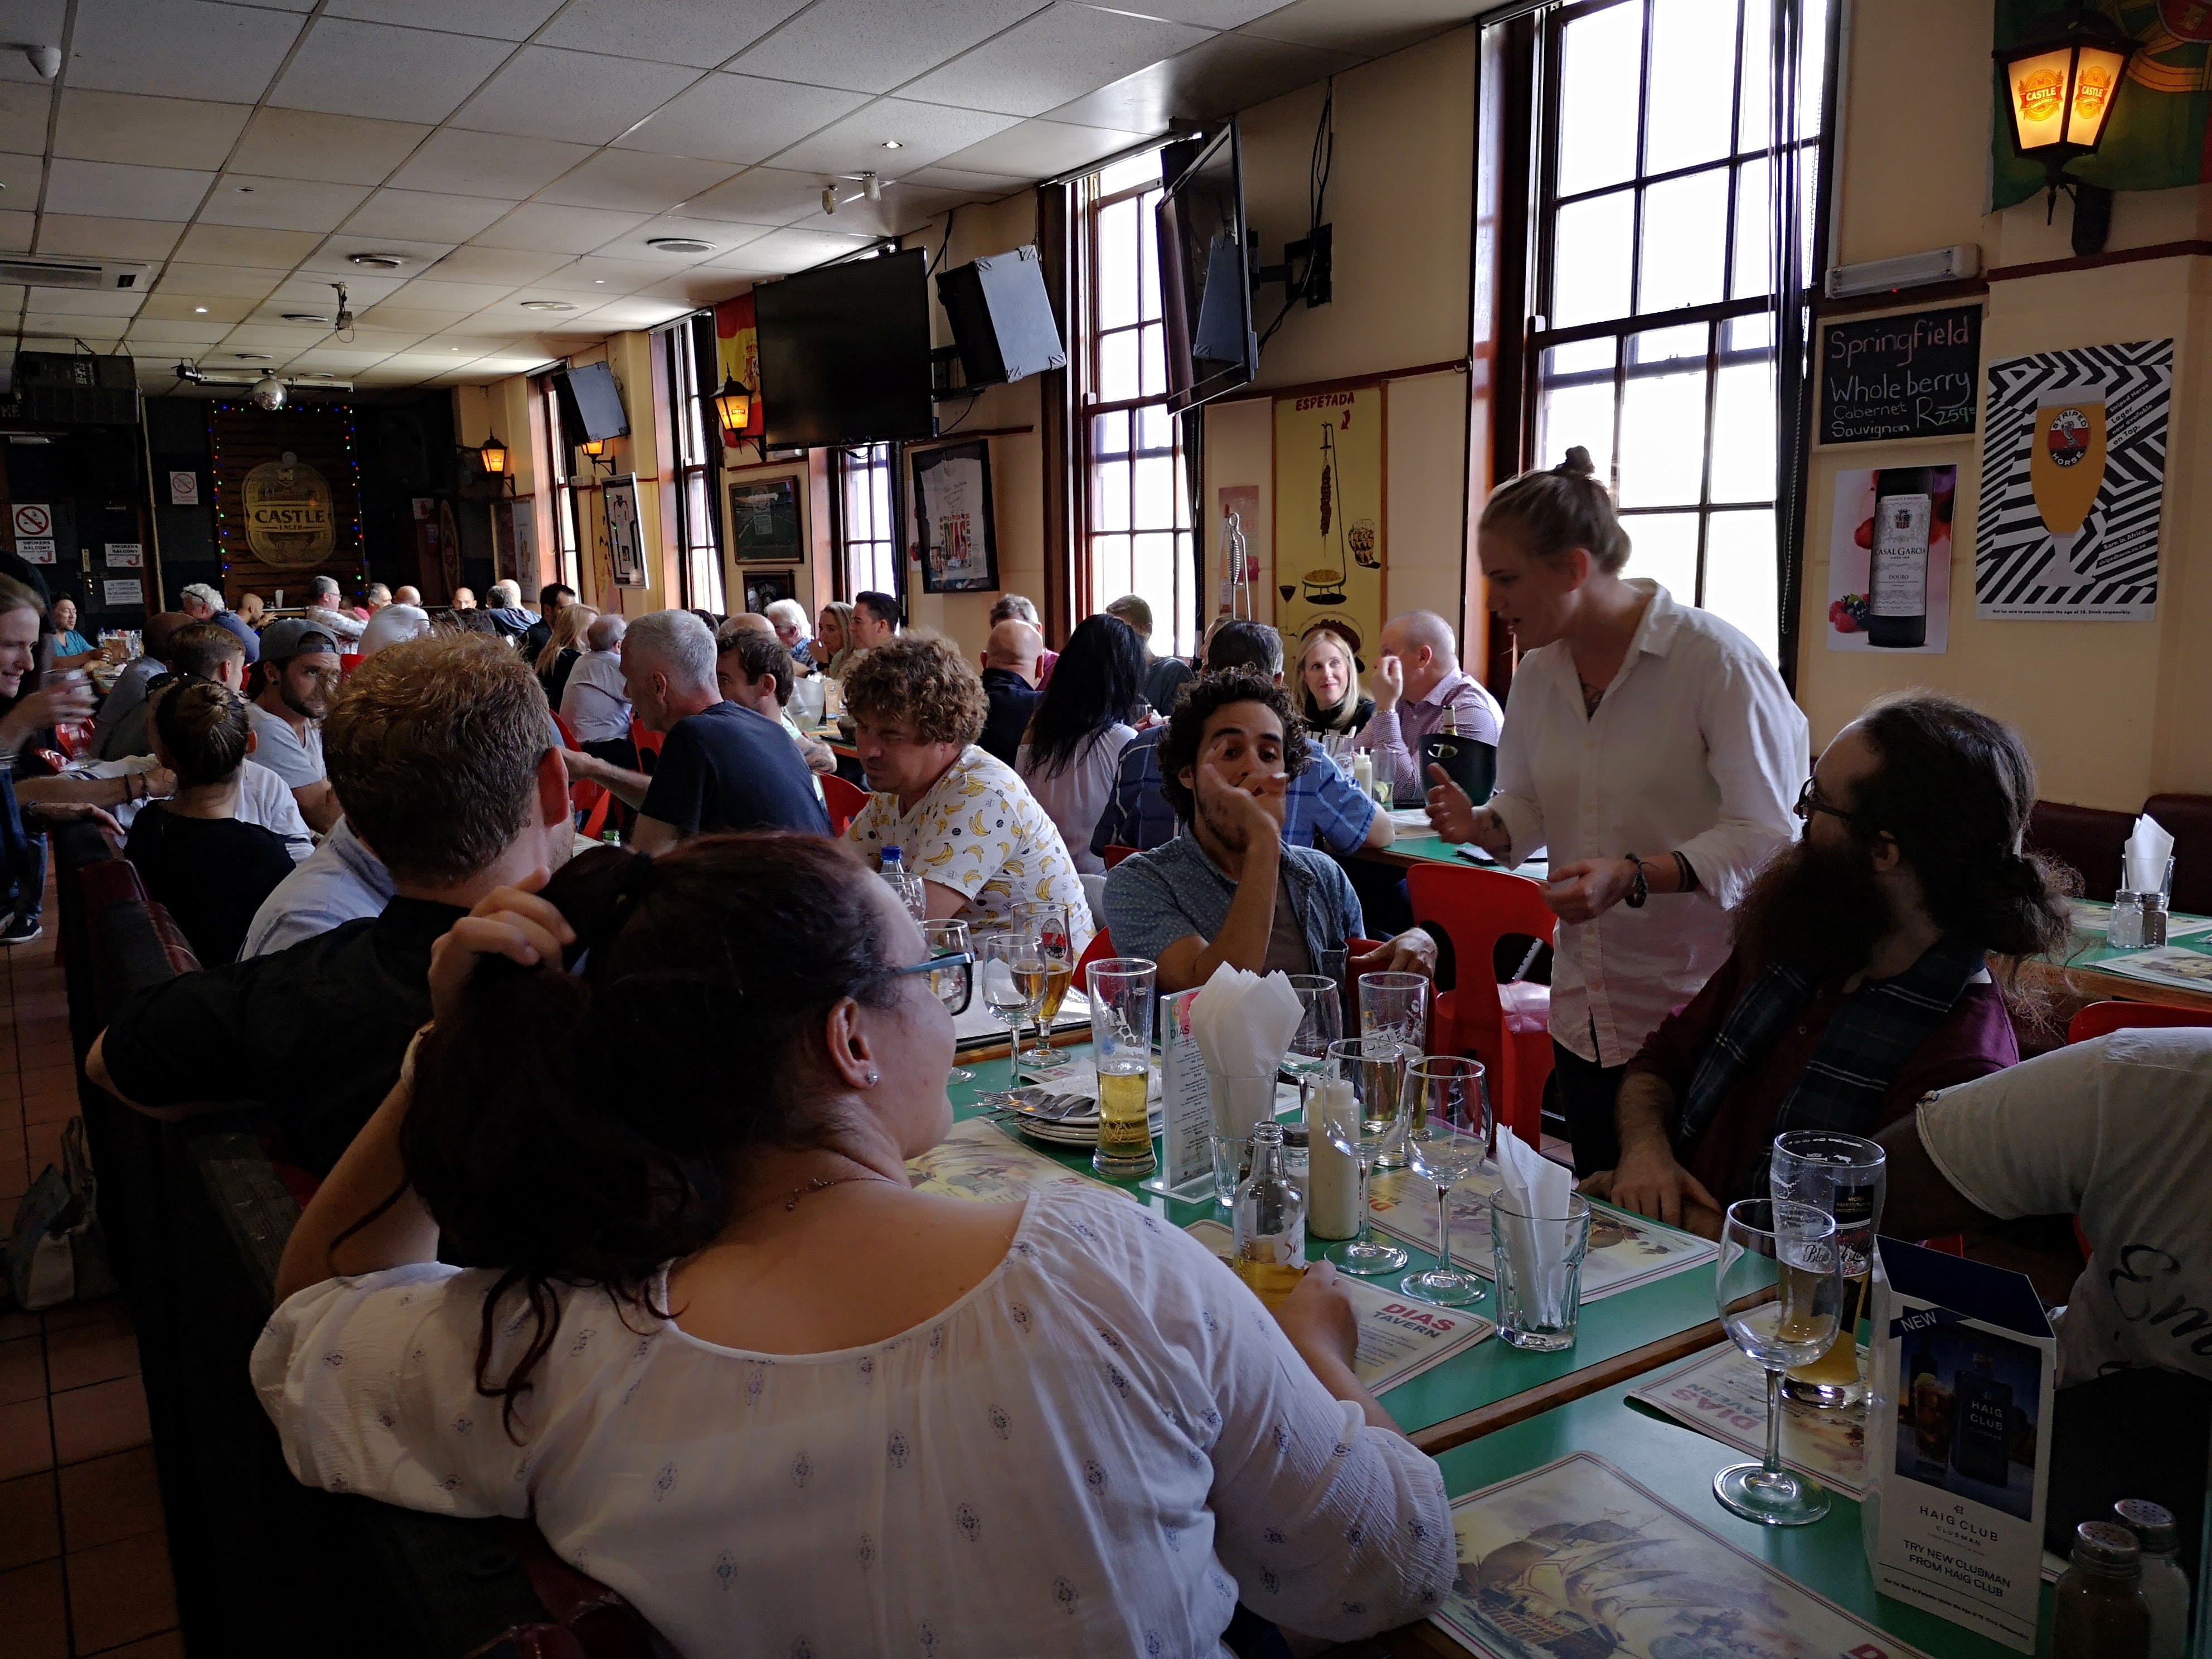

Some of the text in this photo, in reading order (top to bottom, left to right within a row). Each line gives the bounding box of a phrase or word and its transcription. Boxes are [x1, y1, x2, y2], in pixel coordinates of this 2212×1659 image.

[2025, 87, 2056, 101] CASTLE
[2081, 86, 2103, 98] CASTLE
[1831, 315, 1969, 368] Springfield
[1830, 370, 1971, 409] Whole berry
[2109, 384, 2149, 413] Striped Horse
[1295, 392, 1355, 411] ESPETADA
[1833, 401, 1908, 420] Cabernet
[2053, 410, 2087, 430] STRIPED
[2111, 406, 2133, 424] Lager
[2112, 404, 2153, 435] now available
[1831, 420, 1910, 439] Sauvignon
[2113, 425, 2141, 445] on Tap.
[2051, 450, 2084, 467] HORSE
[254, 510, 326, 524] CASTLE
[1874, 547, 1896, 556] CASAL
[1170, 1025, 1190, 1040] DIAS
[1372, 1311, 1442, 1338] TAVERN
[1381, 1303, 1456, 1332] DIAS
[1900, 1311, 1937, 1332] NEW
[1671, 1388, 1760, 1431] DIAS
[1971, 1400, 2004, 1419] HAIG
[1970, 1413, 2004, 1431] CLUB
[1919, 1505, 1998, 1541] HAIG CLUB
[1936, 1525, 1981, 1546] CLUBMAN
[1903, 1539, 1925, 1554] TRY
[1927, 1548, 1954, 1564] NEW
[1955, 1559, 2011, 1588] CLUBMAN
[1909, 1554, 2004, 1598] FROM HAIG CLUB
